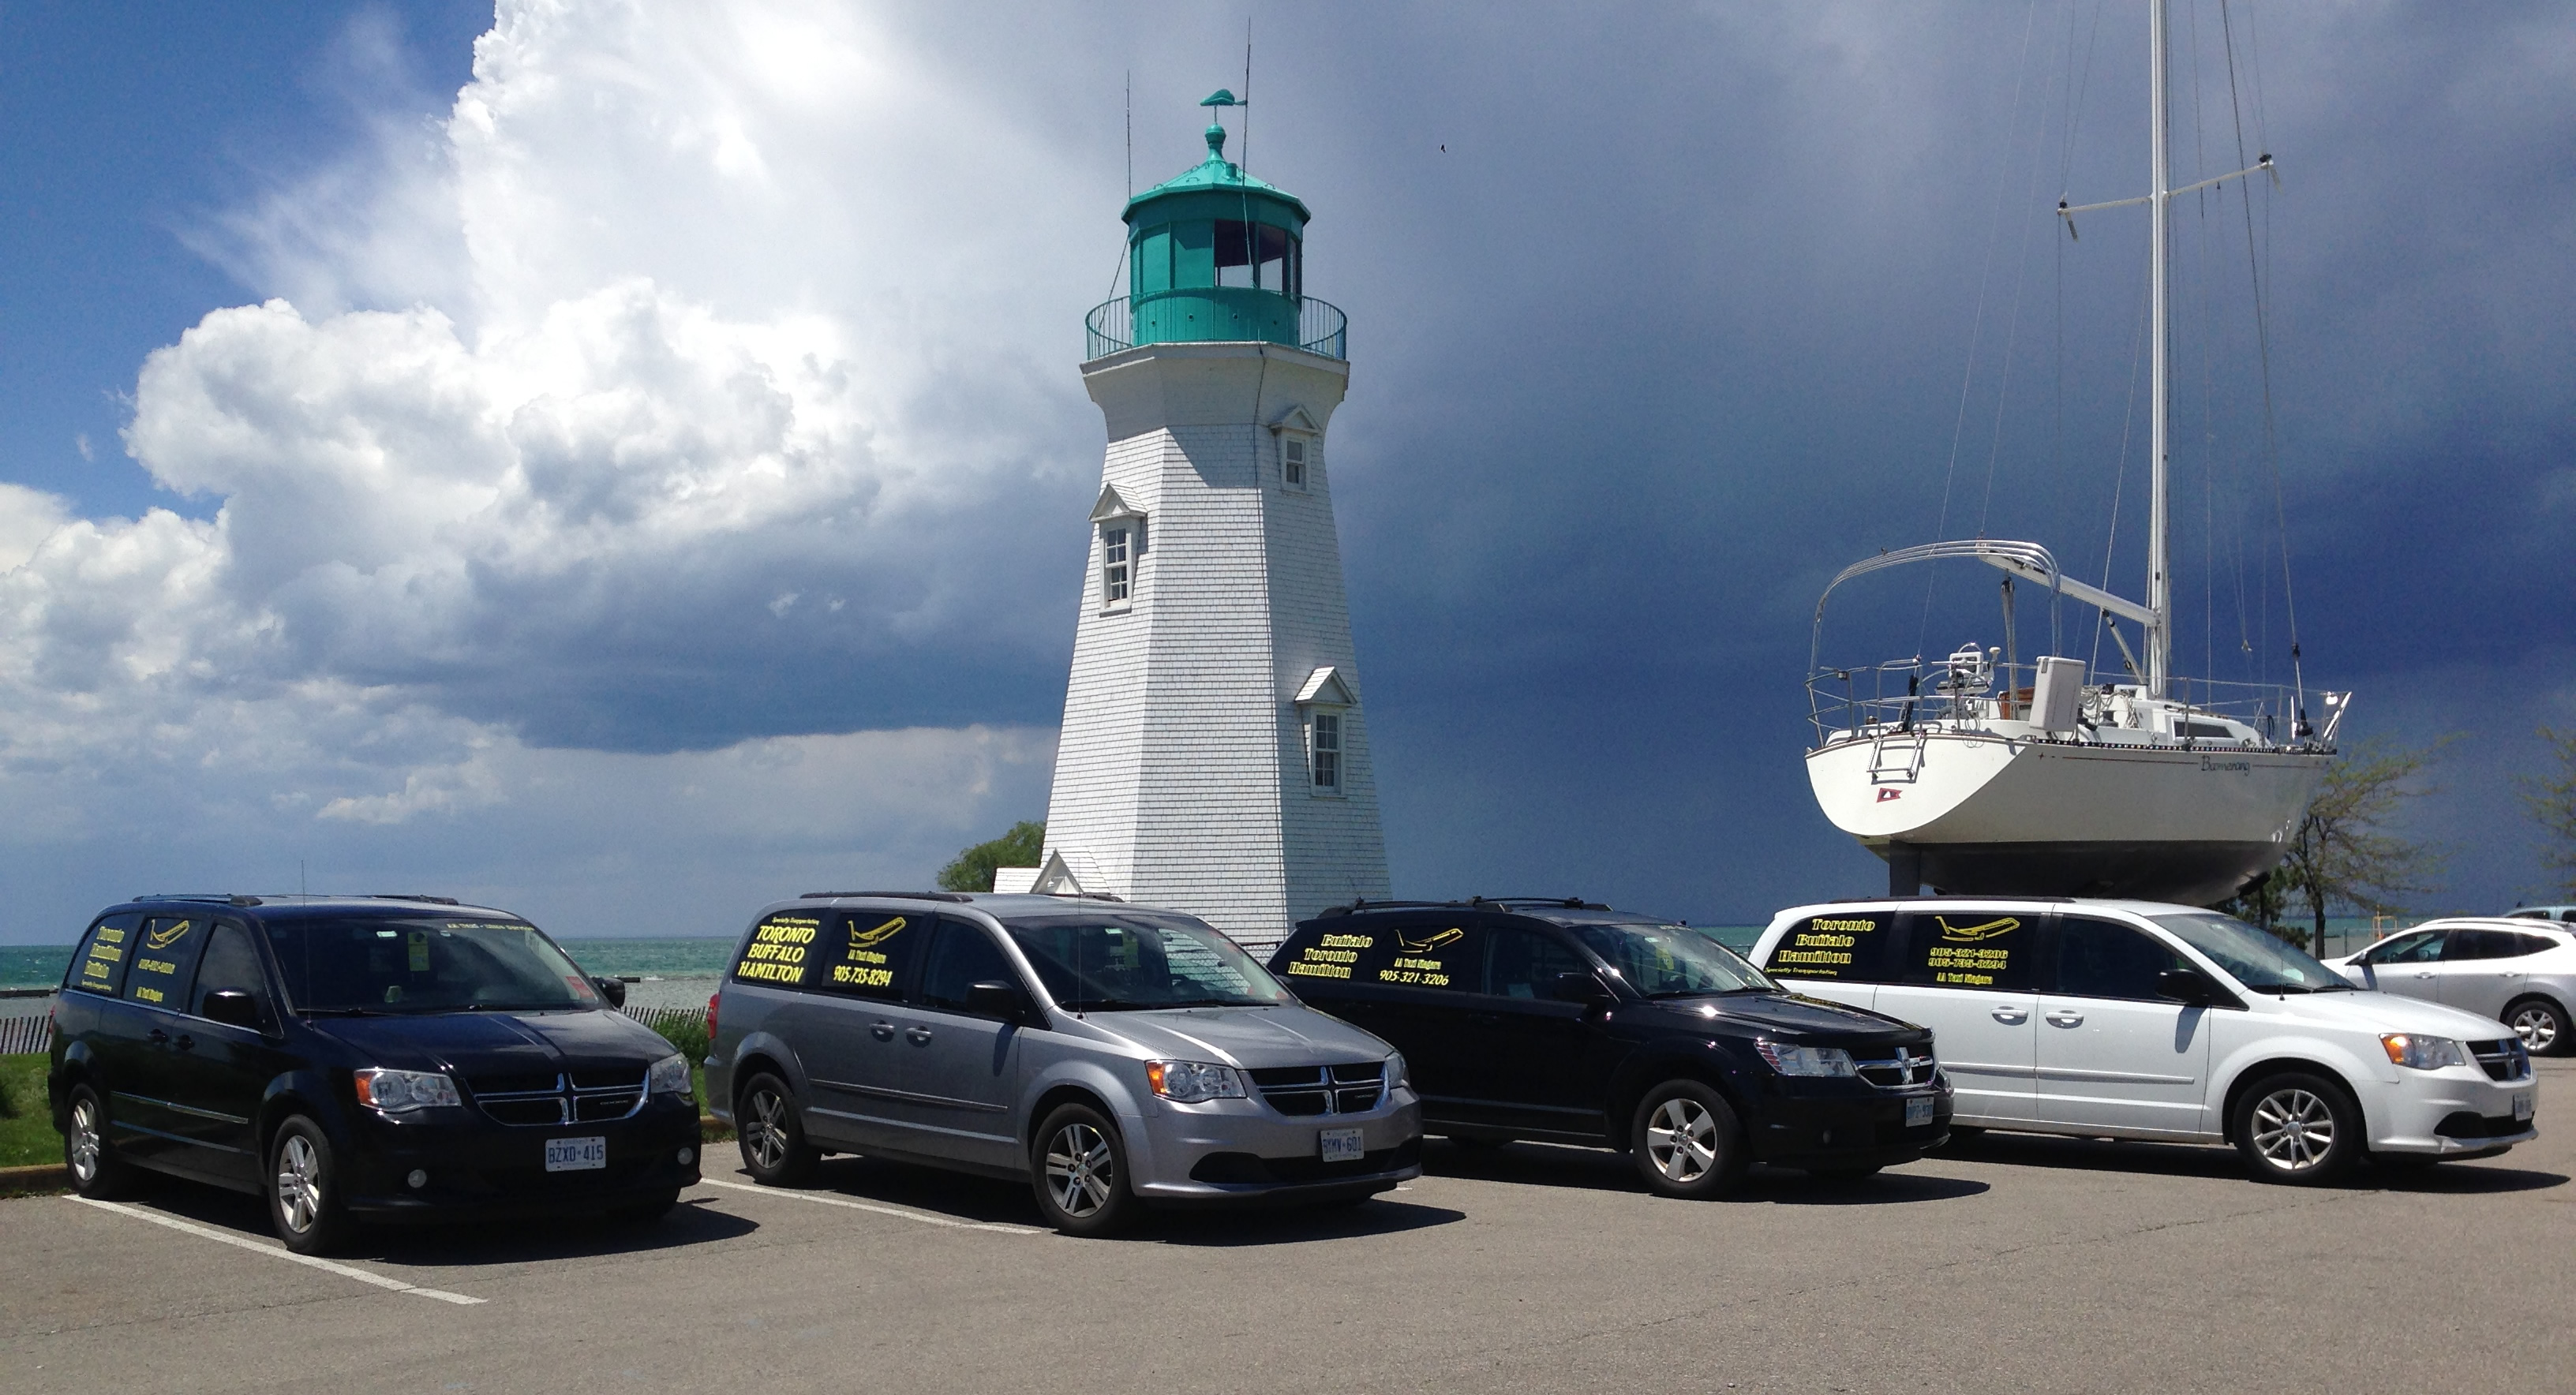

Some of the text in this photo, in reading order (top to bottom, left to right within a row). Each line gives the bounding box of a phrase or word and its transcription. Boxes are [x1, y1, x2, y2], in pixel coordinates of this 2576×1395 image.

[2200, 755, 2251, 776] Boomerang
[1812, 918, 1875, 932] Toronto
[755, 925, 816, 944] TORONTO
[1320, 934, 1372, 948] Buffalo
[1795, 933, 1855, 947] Buffalo
[747, 943, 805, 963] BUFFALO
[1303, 948, 1357, 963] Toronto
[1778, 950, 1852, 964] Hamilton
[1930, 947, 2009, 959] 905-321-3206
[1288, 961, 1351, 978] Hamilton
[1928, 957, 2007, 970] 905-735-8294
[737, 960, 804, 983] HAMILTON
[833, 964, 893, 986] 905-735-8294
[1379, 970, 1450, 985] 905-321-3206
